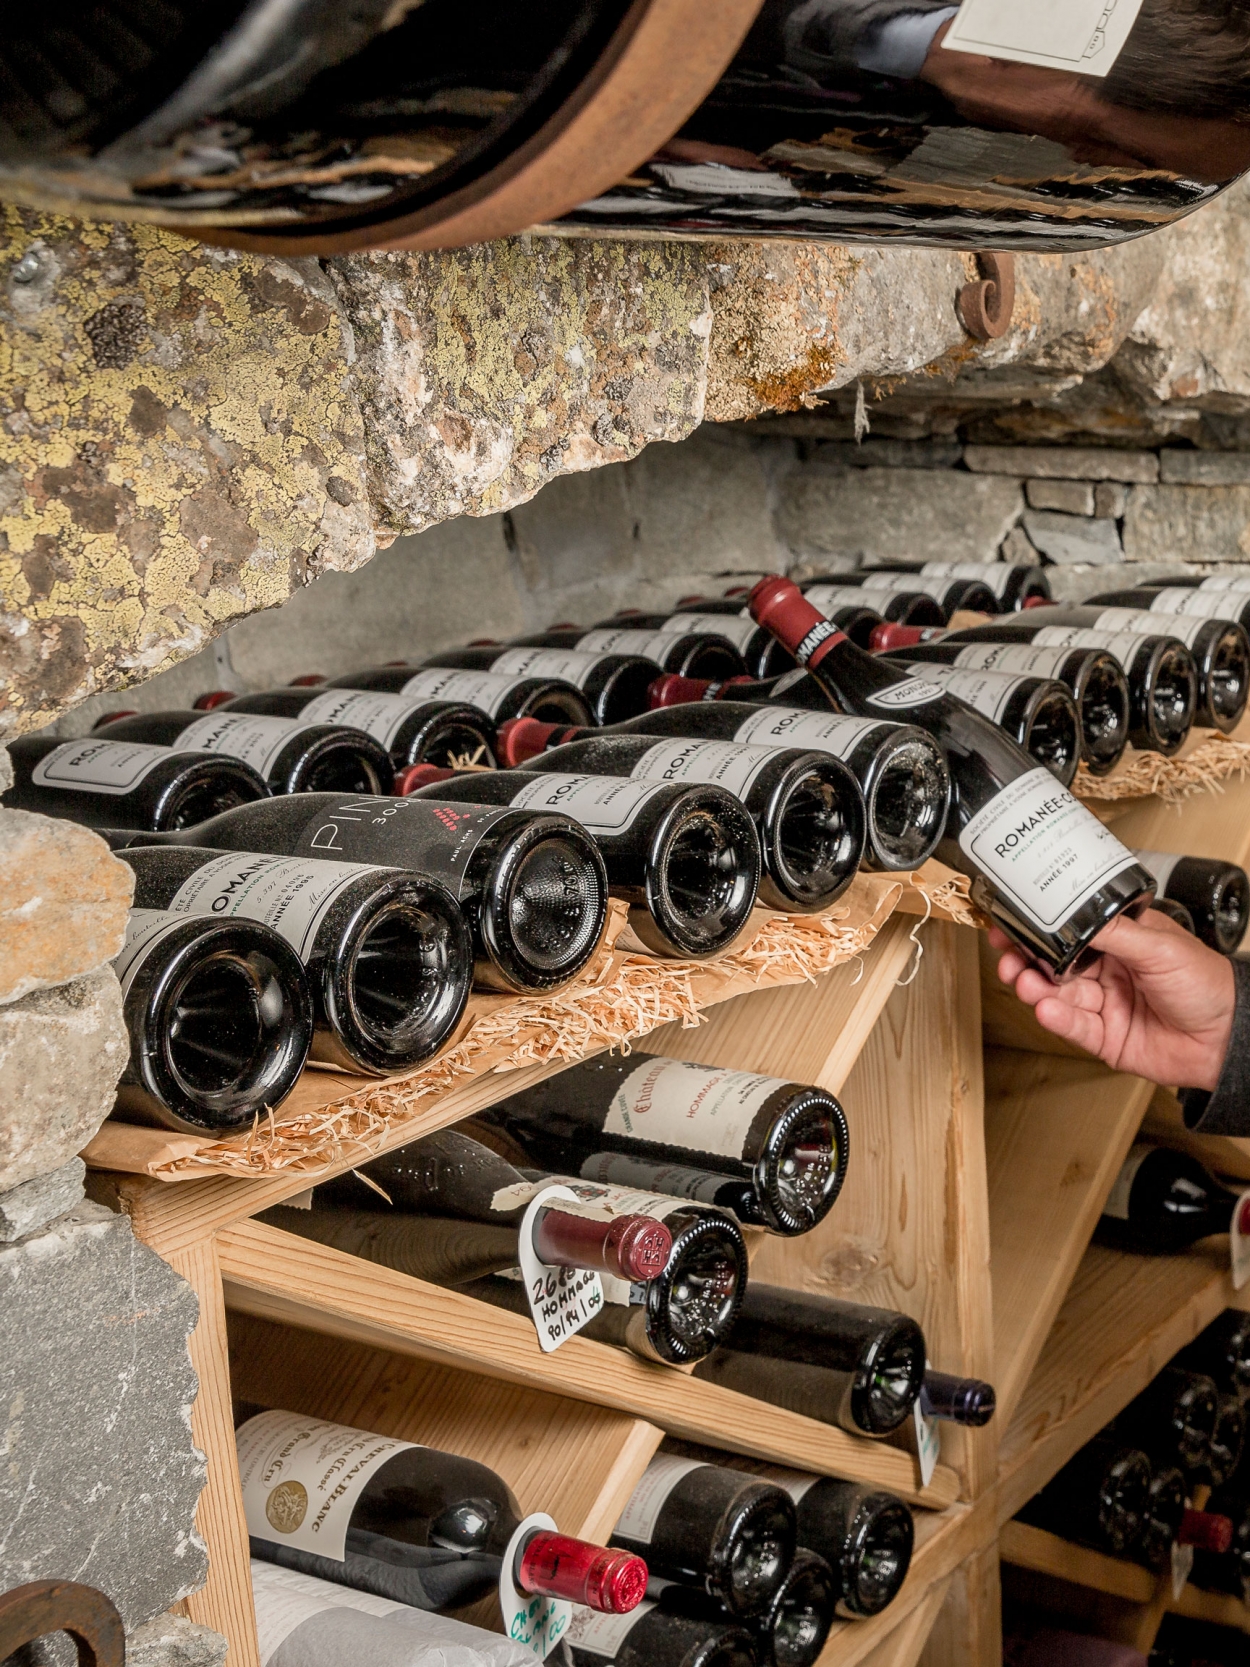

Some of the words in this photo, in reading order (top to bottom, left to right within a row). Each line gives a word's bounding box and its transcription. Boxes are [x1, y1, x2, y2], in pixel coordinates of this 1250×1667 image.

[310, 796, 391, 851] PIN
[450, 846, 462, 863] PAUL
[183, 877, 211, 914] OPRIÉTAIRE
[229, 873, 265, 917] PPELLATION
[632, 1064, 667, 1115] Château
[686, 1076, 722, 1120] HOMMAGE
[263, 1458, 285, 1483] Cru
[316, 1457, 347, 1492] Classé
[311, 1483, 351, 1533] BLANC
